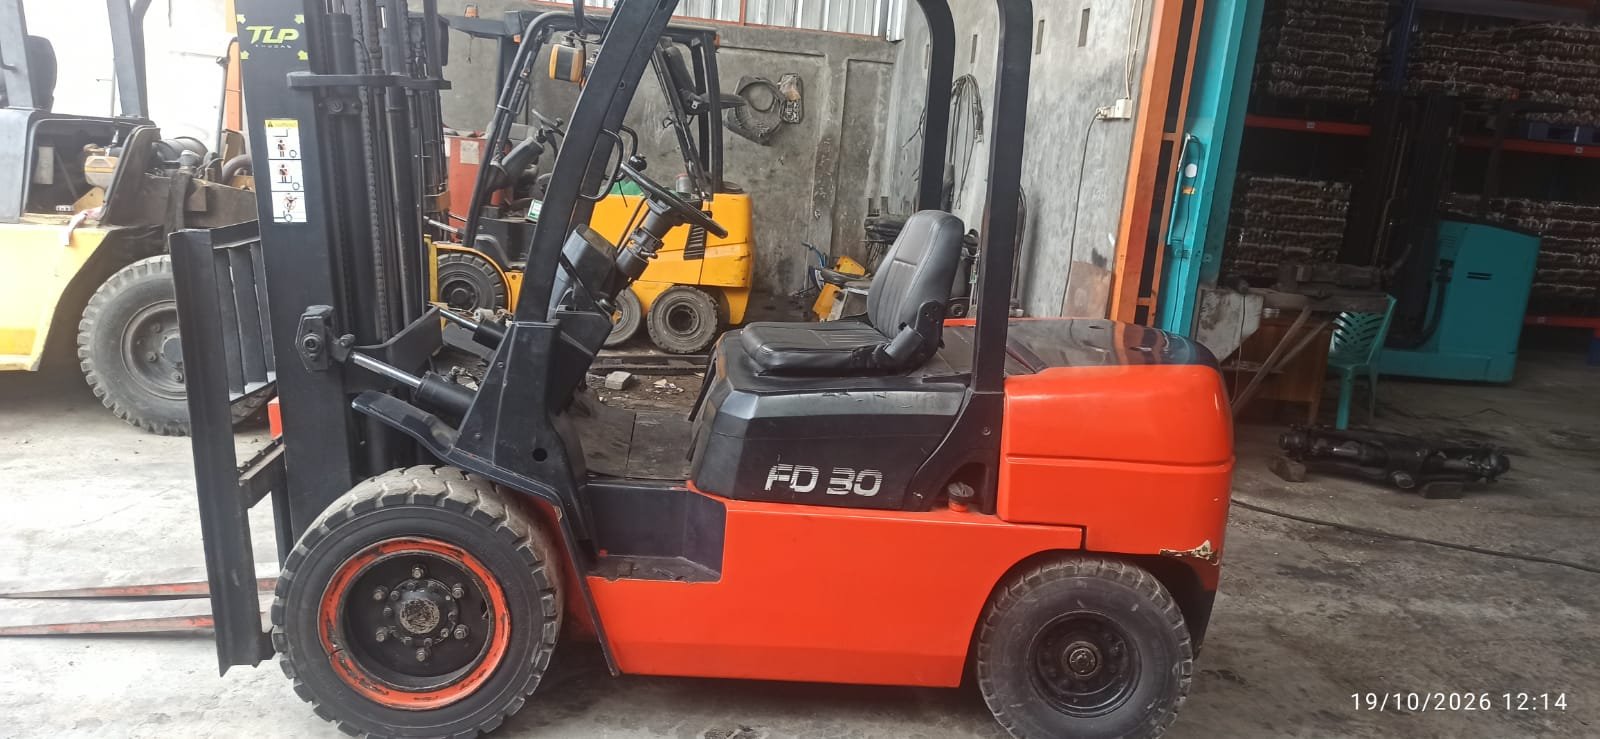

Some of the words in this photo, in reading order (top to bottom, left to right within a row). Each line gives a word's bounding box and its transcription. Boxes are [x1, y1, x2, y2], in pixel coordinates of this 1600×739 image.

[245, 25, 300, 44] TLP
[764, 463, 819, 493] FD
[826, 467, 883, 496] 30
